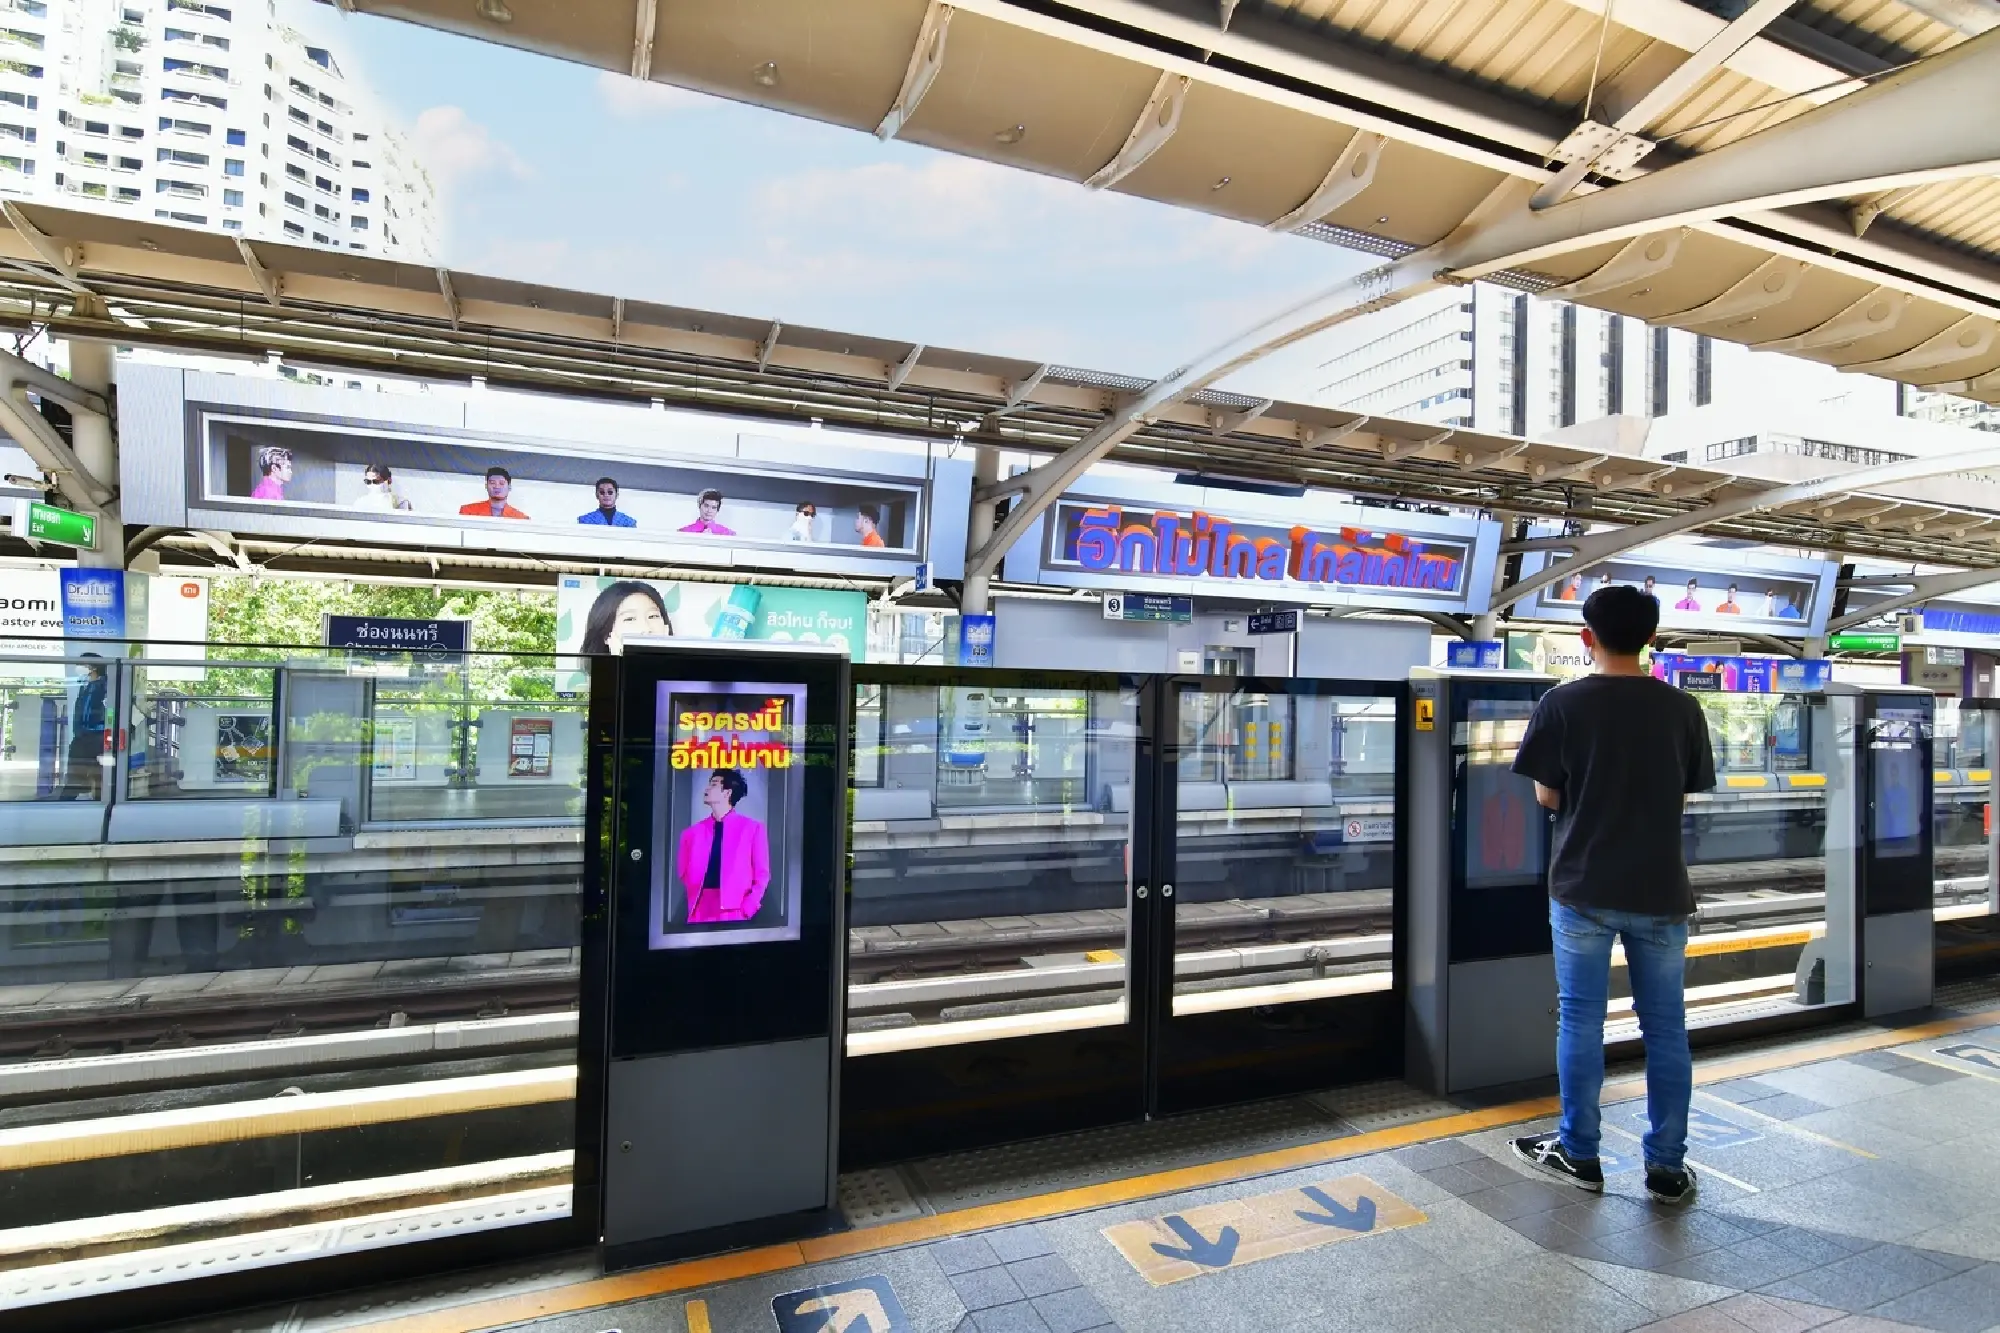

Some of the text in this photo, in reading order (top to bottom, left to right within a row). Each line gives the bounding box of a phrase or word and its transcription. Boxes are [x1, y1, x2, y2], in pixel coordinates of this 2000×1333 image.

[32, 522, 45, 534] Exit
[356, 622, 438, 641] ช่องนนทรี
[679, 698, 785, 731] รอตรงนี้
[670, 737, 791, 769] อีกไม่นาน
